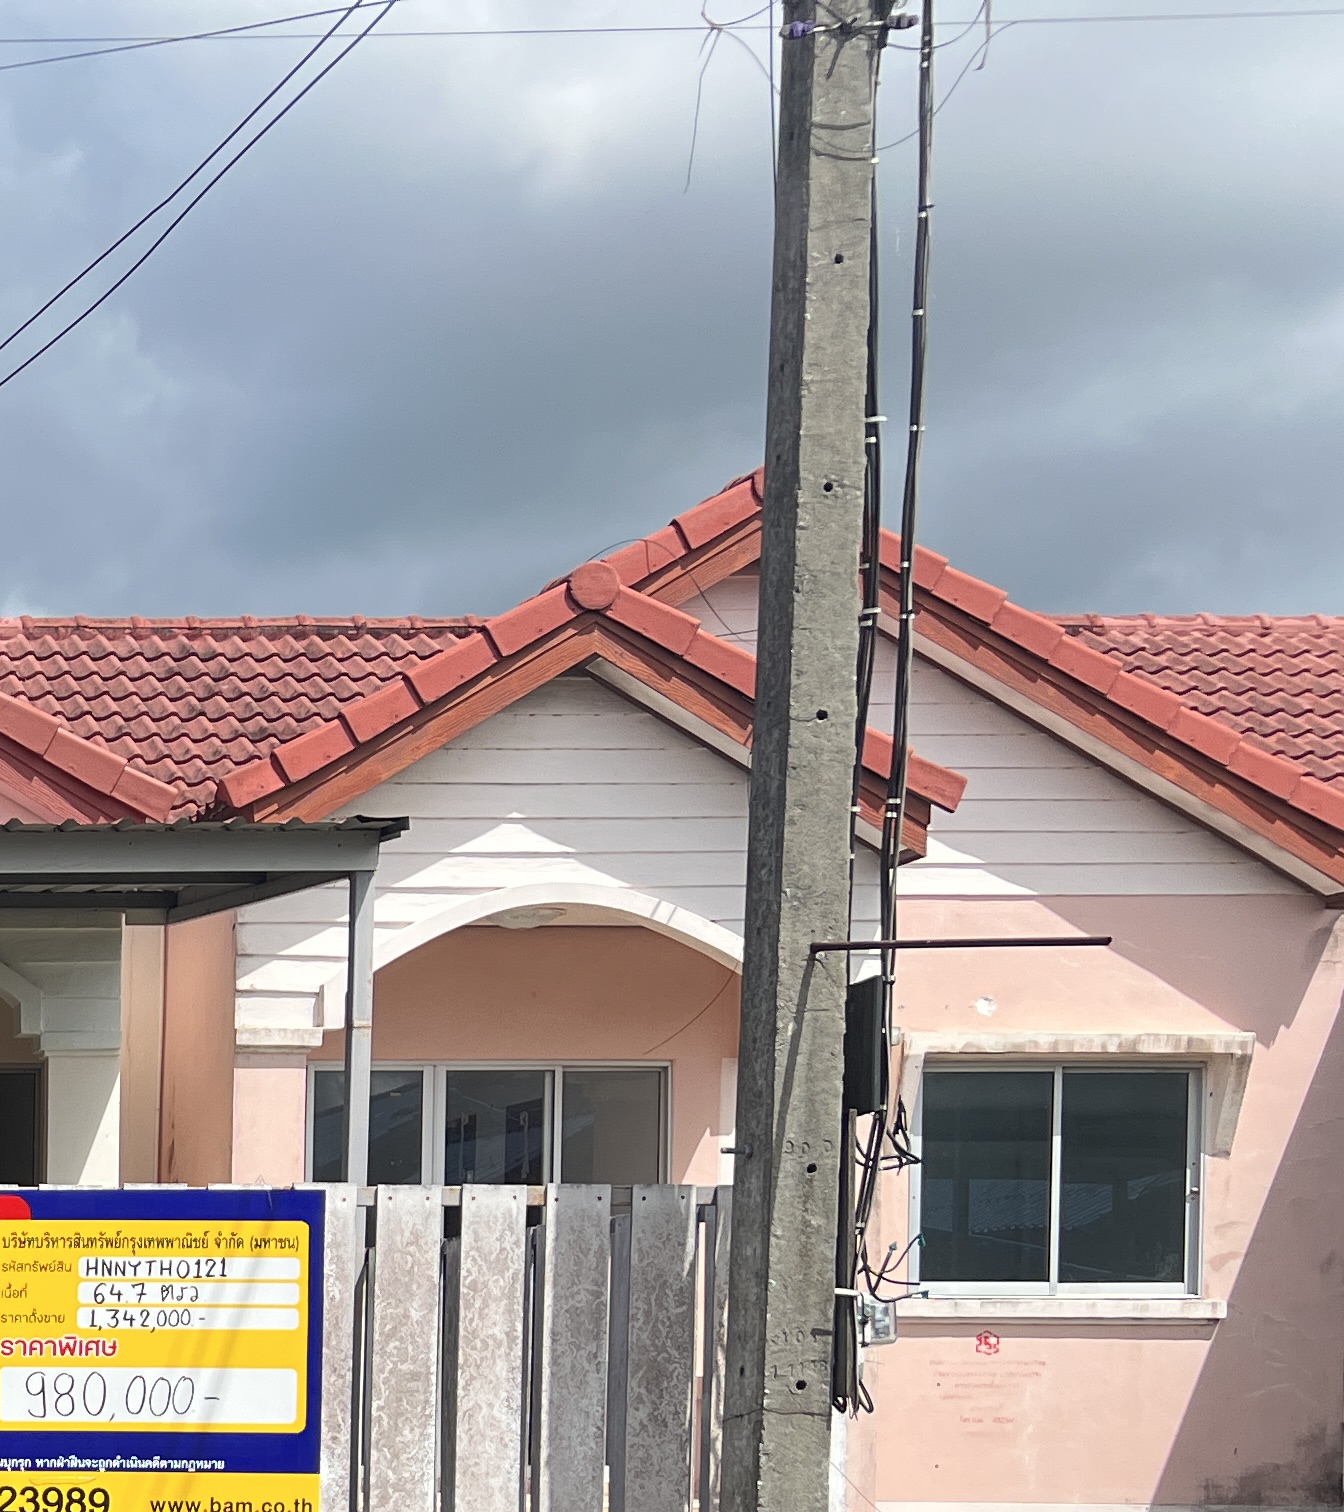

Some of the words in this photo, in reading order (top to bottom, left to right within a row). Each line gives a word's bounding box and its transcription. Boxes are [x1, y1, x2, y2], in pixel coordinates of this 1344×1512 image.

[214, 1231, 244, 1249] จำกัด
[250, 1235, 299, 1252] (มหาชน)
[1, 1260, 72, 1273] รหัสทรัพย์สิน
[1, 1282, 28, 1298] เนื้อที่
[0, 1308, 66, 1323] ราคาตั้งขาย
[0, 1336, 118, 1357] ราคาพิเศษ
